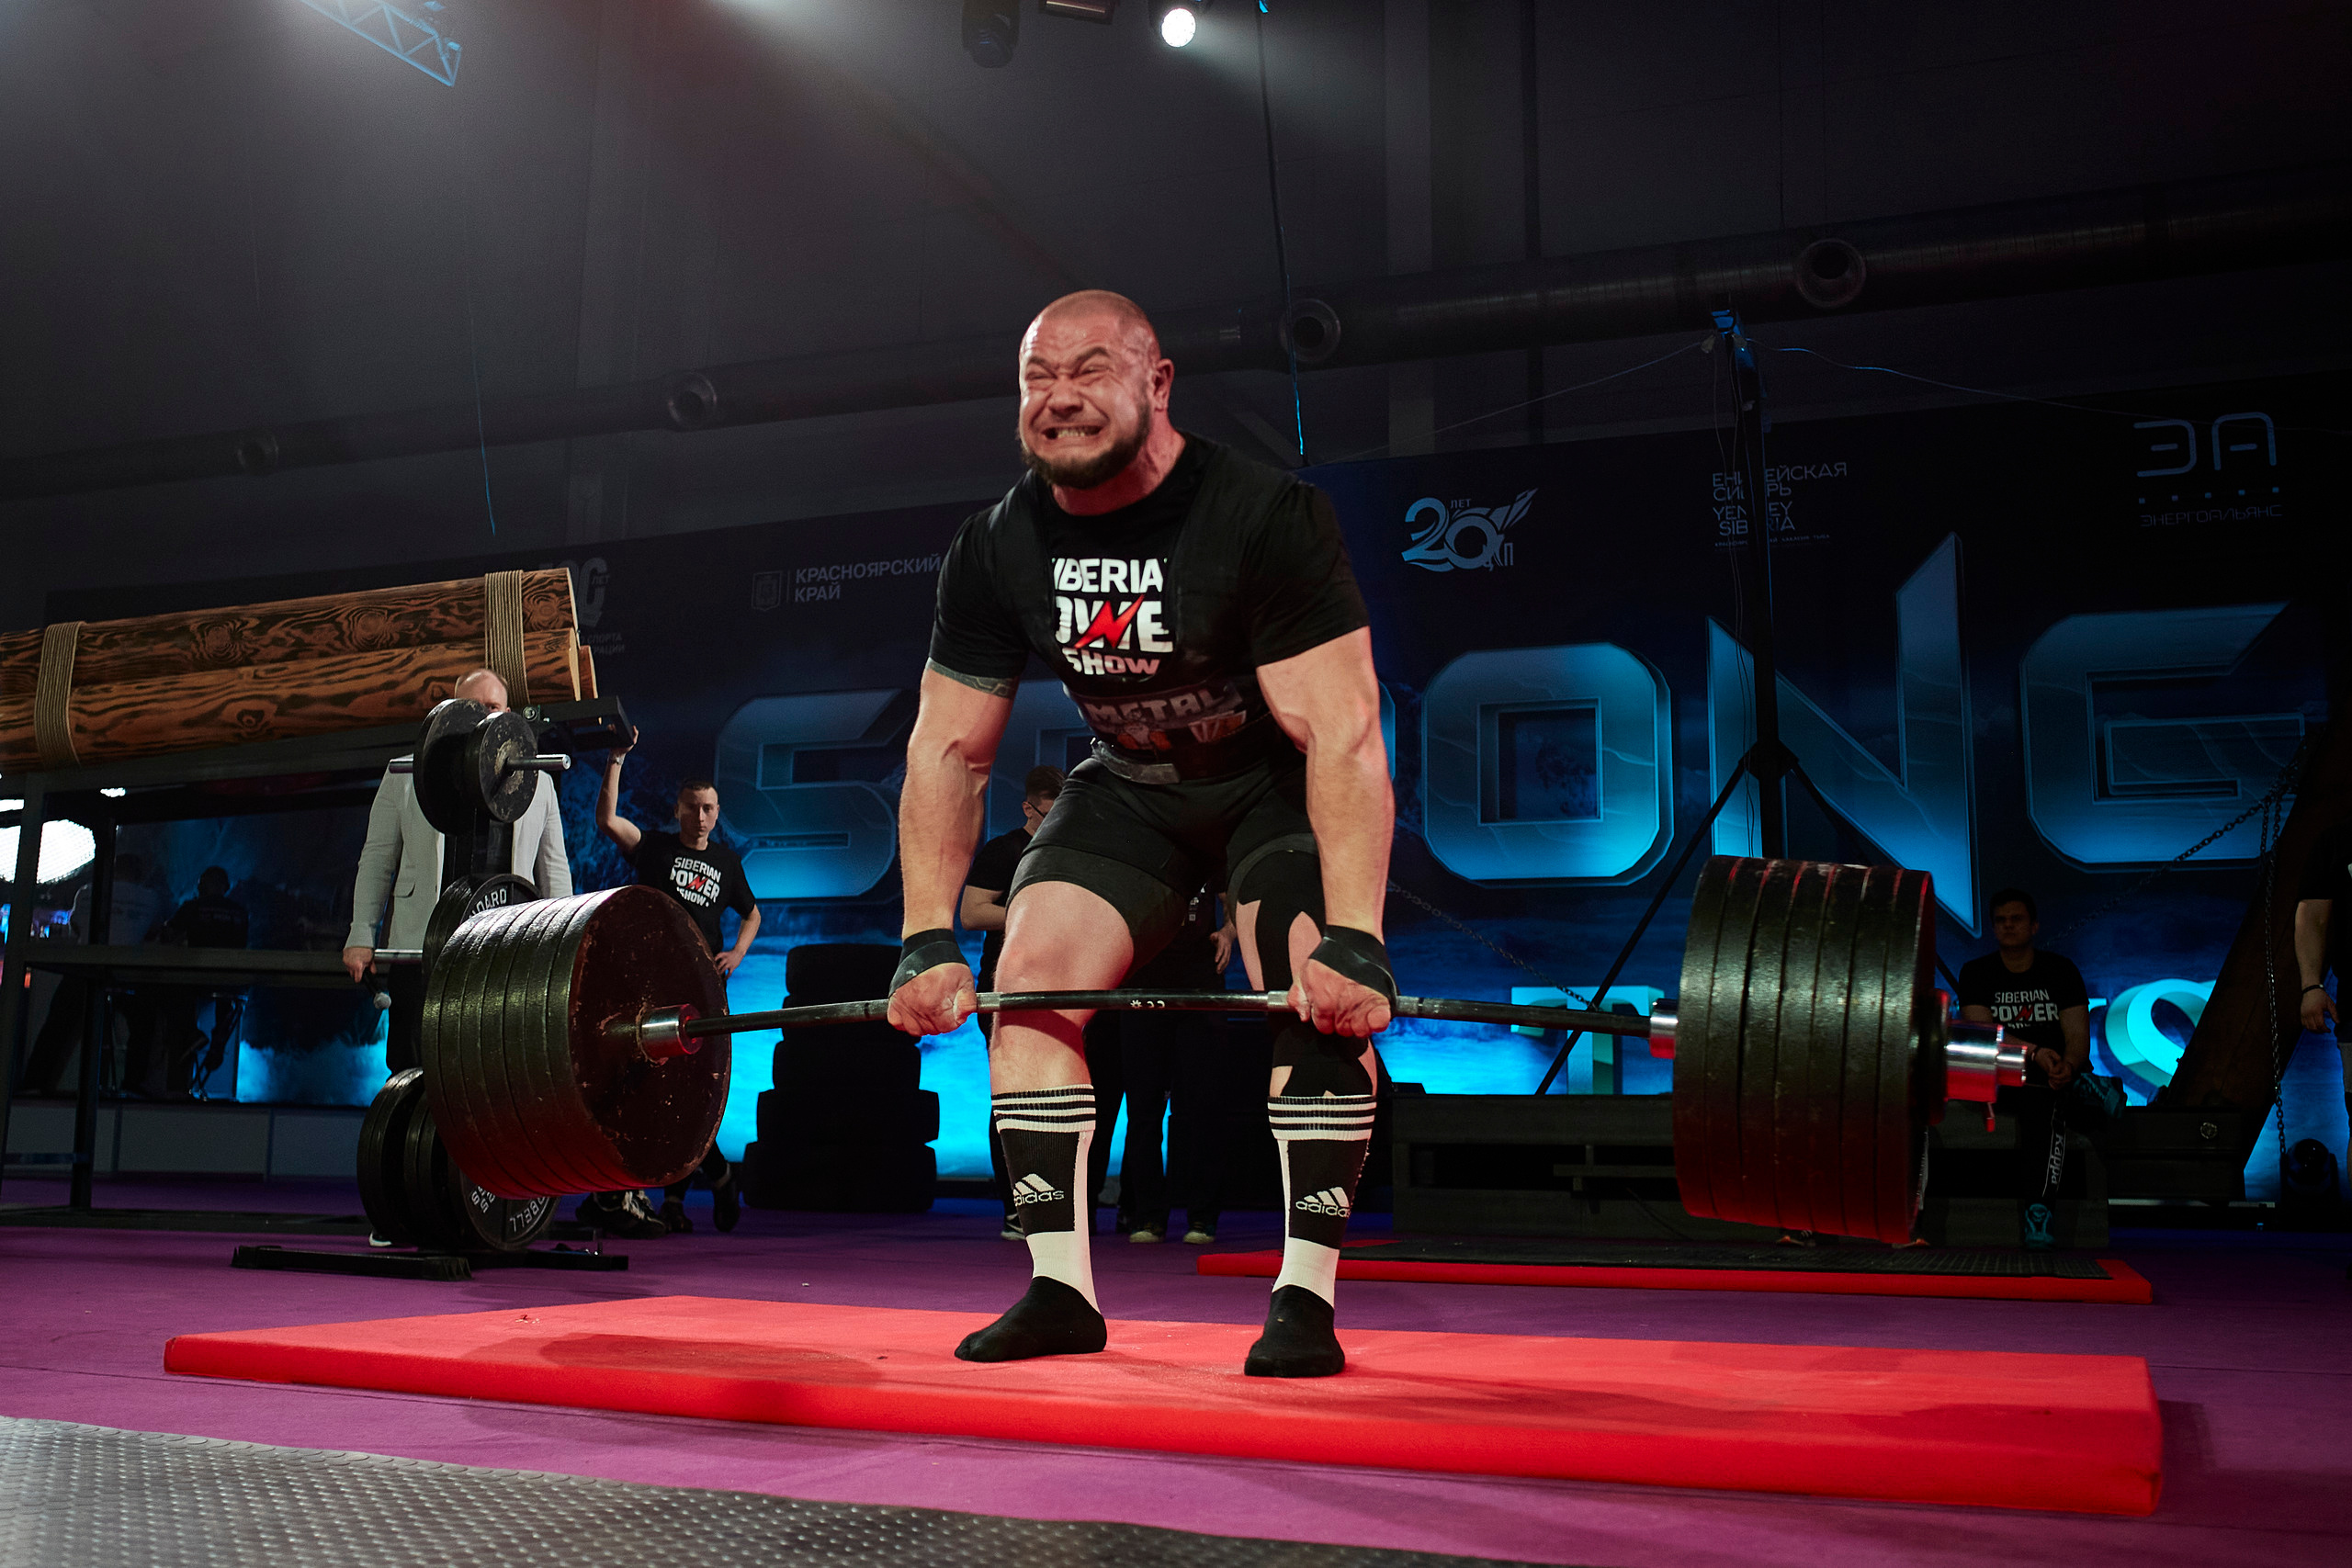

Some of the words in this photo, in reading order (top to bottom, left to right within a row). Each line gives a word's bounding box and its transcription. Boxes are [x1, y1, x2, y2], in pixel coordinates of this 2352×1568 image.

[1712, 461, 1848, 488] ЕНЕЙСКАЯ
[1450, 499, 1472, 509] ЛЕТ
[1713, 482, 1792, 502] СИРЬ
[1713, 501, 1792, 522] YENEY
[2139, 504, 2285, 527] ЭНЕРГОАЛЬЯНС
[1401, 497, 1500, 573] 20
[1719, 516, 1796, 536] SIBRIA
[796, 553, 942, 583] КРАСНОЯРСКИЙ
[1051, 557, 1168, 593] IBERIA
[794, 581, 842, 603] КРАЙ
[1061, 647, 1161, 676] SHOW
[1084, 689, 1226, 724] METAL
[714, 531, 2306, 935] SONG
[673, 856, 722, 884] SIBERIAN
[1995, 988, 2050, 1004] SIBERIAN
[2049, 1133, 2064, 1185] Kappa
[1013, 1190, 1065, 1208] didas
